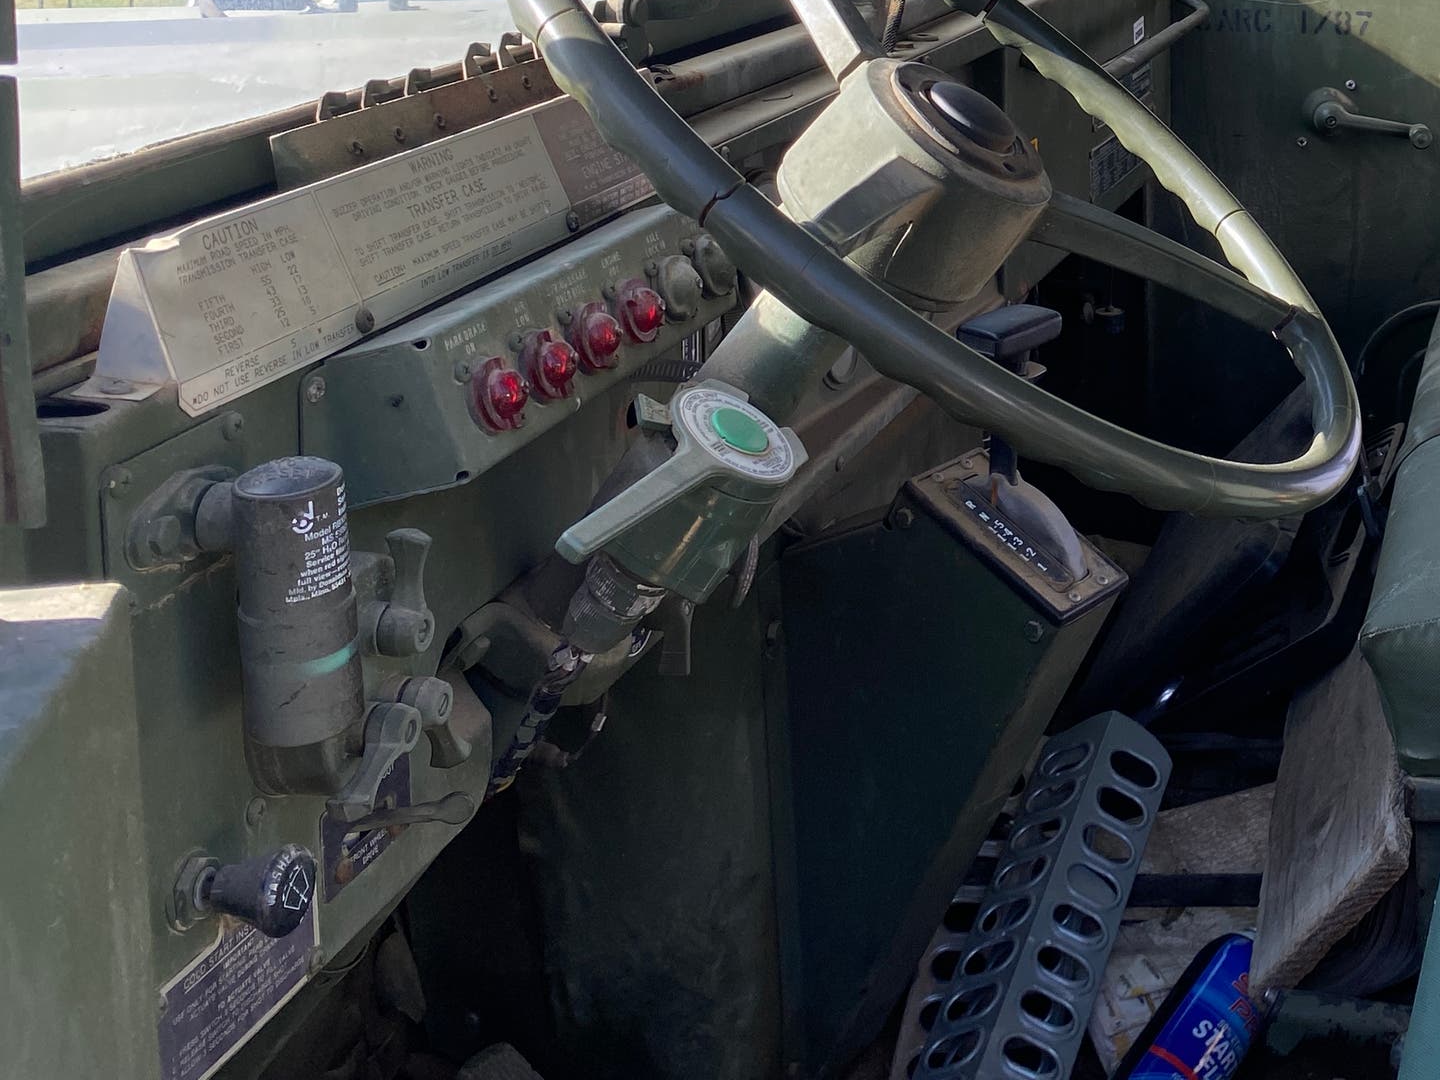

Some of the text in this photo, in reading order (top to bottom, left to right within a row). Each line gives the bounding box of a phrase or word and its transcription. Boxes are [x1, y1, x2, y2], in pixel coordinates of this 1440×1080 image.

[408, 149, 454, 172] WARNING
[407, 190, 457, 220] TRANSFER
[461, 178, 487, 198] CASE
[202, 219, 259, 249] CAUTION
[210, 246, 232, 263] ROAD
[235, 237, 258, 252] SPEED
[262, 233, 272, 242] IN
[178, 234, 299, 287] TRANSMISSION TRANSFER CASE
[251, 251, 296, 275] HIGH LOW
[199, 295, 226, 310] FIFTH
[204, 304, 236, 322] FOURTH
[209, 317, 235, 334] THIRD
[213, 327, 245, 345] SECOND
[218, 339, 244, 355] FIRST
[213, 383, 230, 397] NOT
[234, 374, 250, 388] USE
[254, 355, 288, 377] REVERSE
[293, 350, 302, 360] IN
[305, 341, 320, 354] LOW
[224, 354, 261, 379] REVERSE
[965, 500, 976, 510] R
[979, 512, 990, 522] N
[304, 525, 332, 541] Model
[322, 533, 334, 545] MS
[301, 560, 336, 577] when red
[306, 553, 335, 568] Service
[1037, 563, 1047, 571] 1
[297, 576, 312, 586] full
[308, 584, 316, 592] by
[183, 963, 207, 990] COLD
[208, 938, 232, 965] START
